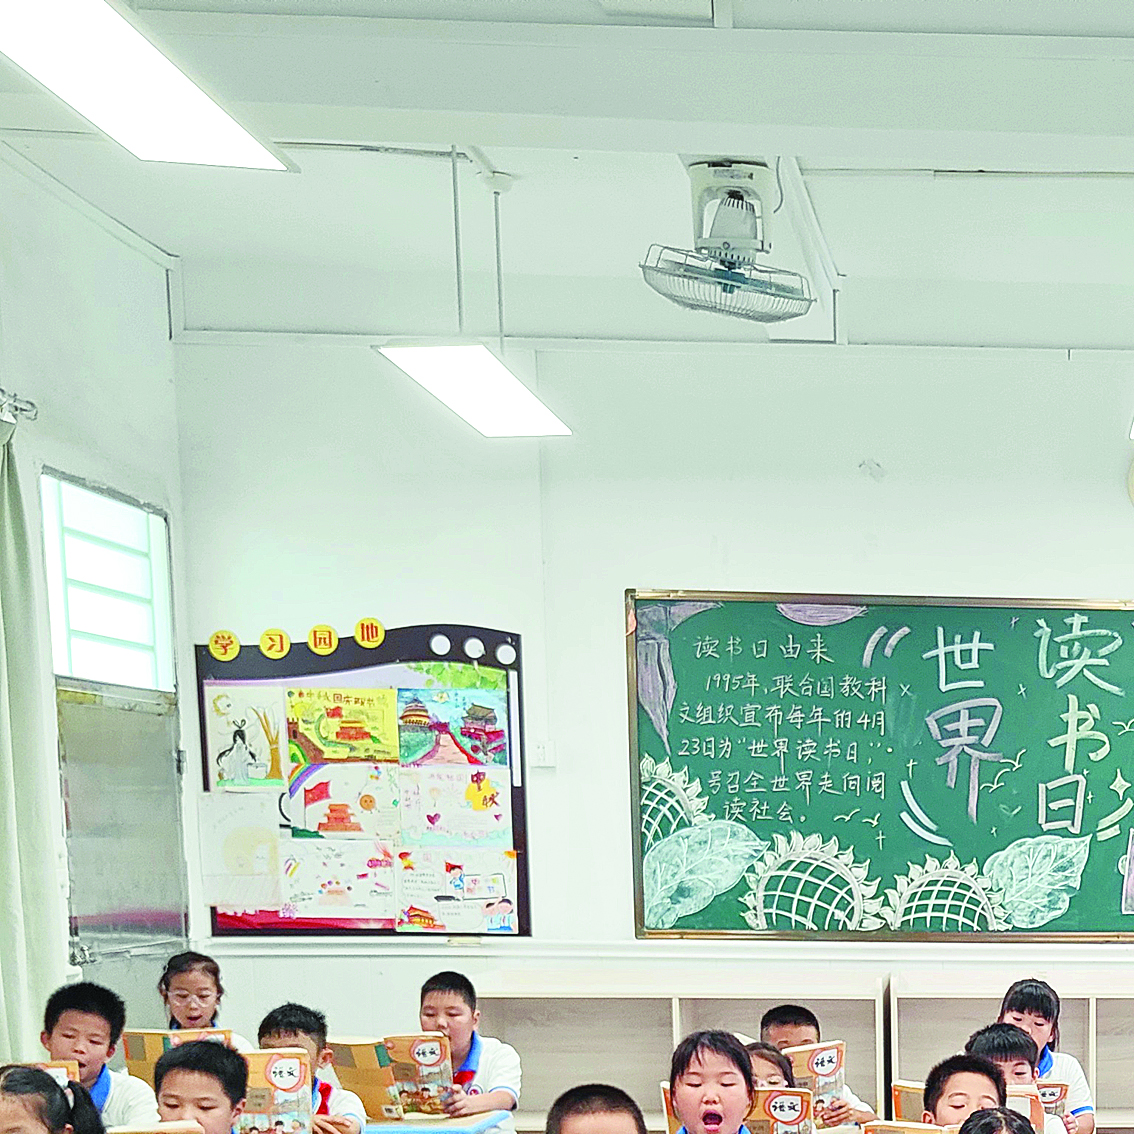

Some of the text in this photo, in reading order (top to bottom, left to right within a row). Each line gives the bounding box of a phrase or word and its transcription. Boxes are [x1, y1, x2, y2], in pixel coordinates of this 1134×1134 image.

[213, 622, 380, 656] 学习园地
[693, 632, 835, 664] 读书日由来
[921, 625, 1004, 825] 世界
[1033, 613, 1127, 835] 读书日
[708, 770, 886, 805] 号召全世界走向阅
[772, 1101, 800, 1113] 语文
